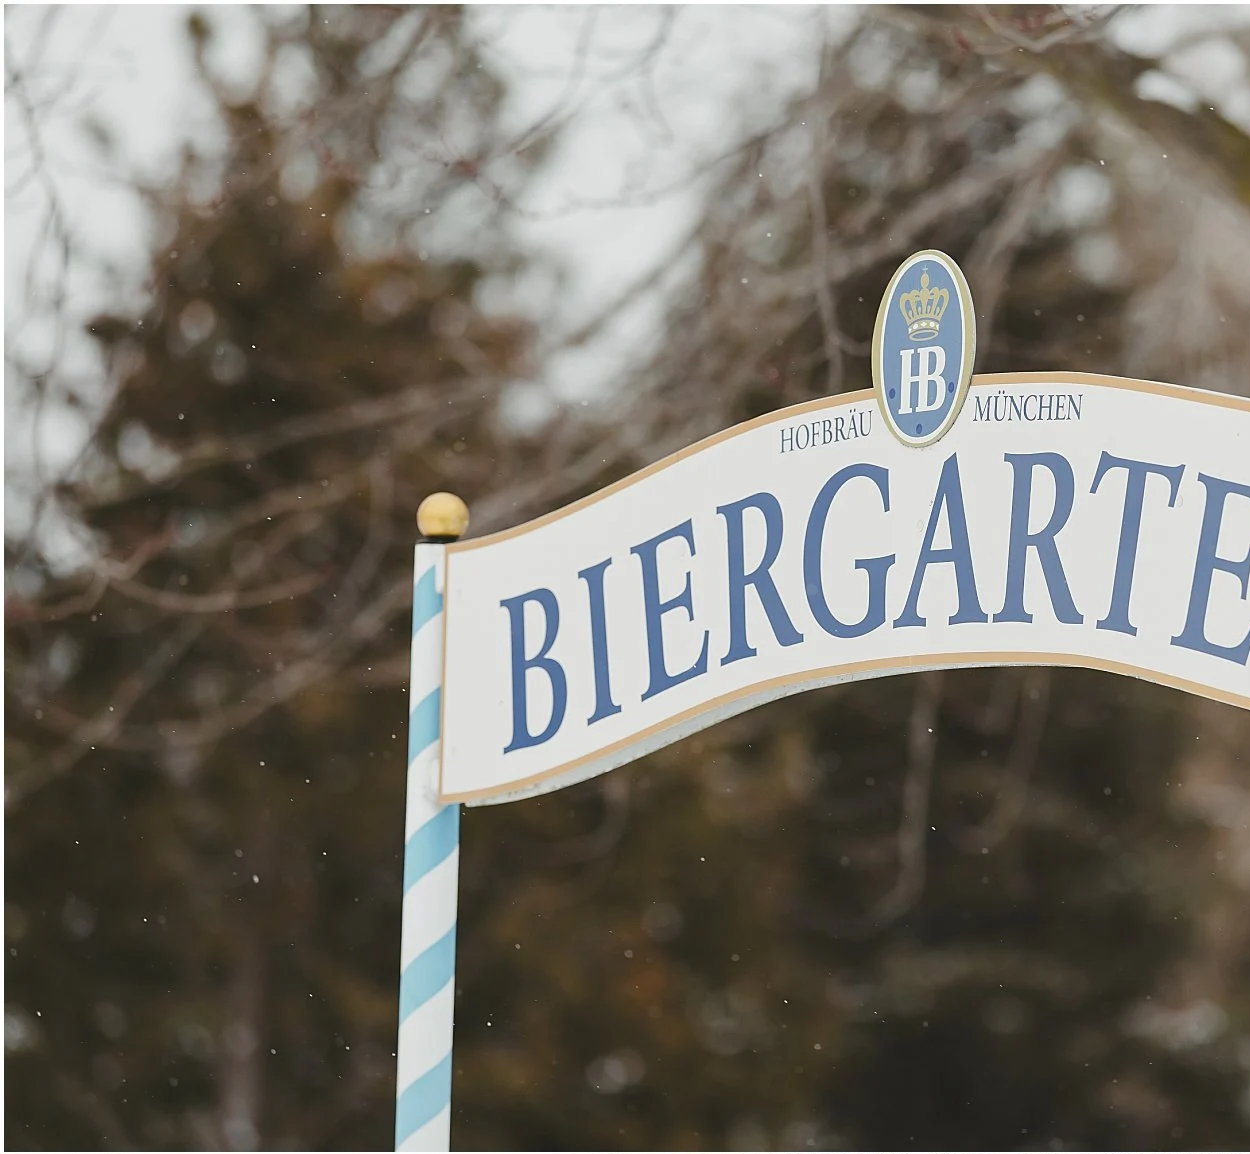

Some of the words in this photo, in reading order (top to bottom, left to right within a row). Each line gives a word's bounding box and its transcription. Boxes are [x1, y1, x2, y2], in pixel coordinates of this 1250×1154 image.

[898, 345, 947, 415] HB
[780, 409, 873, 453] HOFBRÄU
[972, 391, 1083, 422] MÜNCHEN
